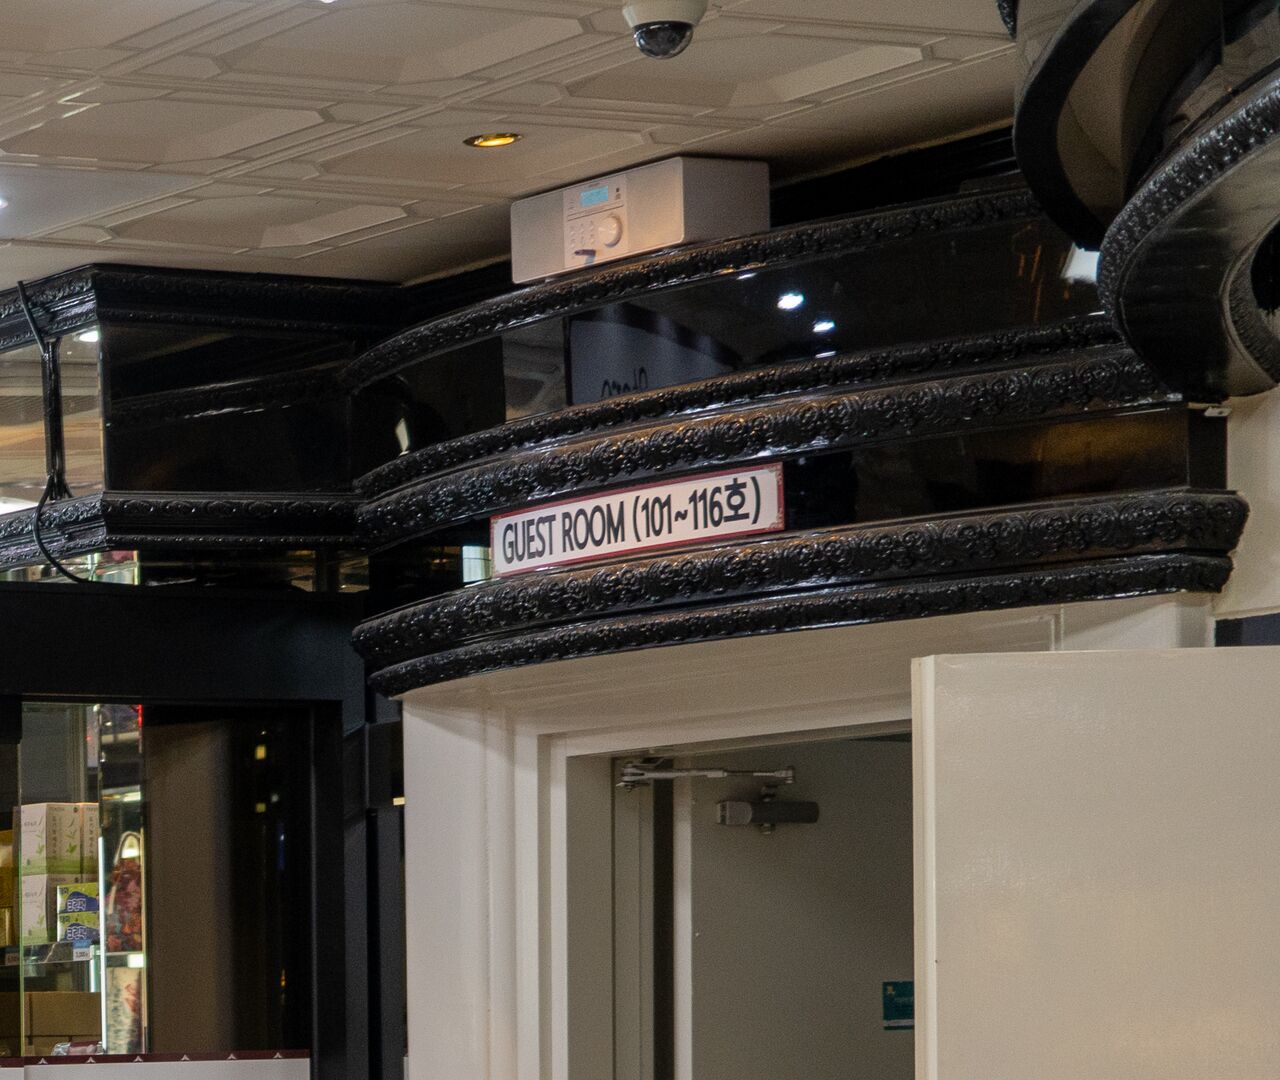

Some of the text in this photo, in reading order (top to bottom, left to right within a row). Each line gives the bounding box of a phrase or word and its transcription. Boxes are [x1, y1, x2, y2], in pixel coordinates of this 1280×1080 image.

[502, 475, 762, 564] GUEST ROOM (101~116호)
